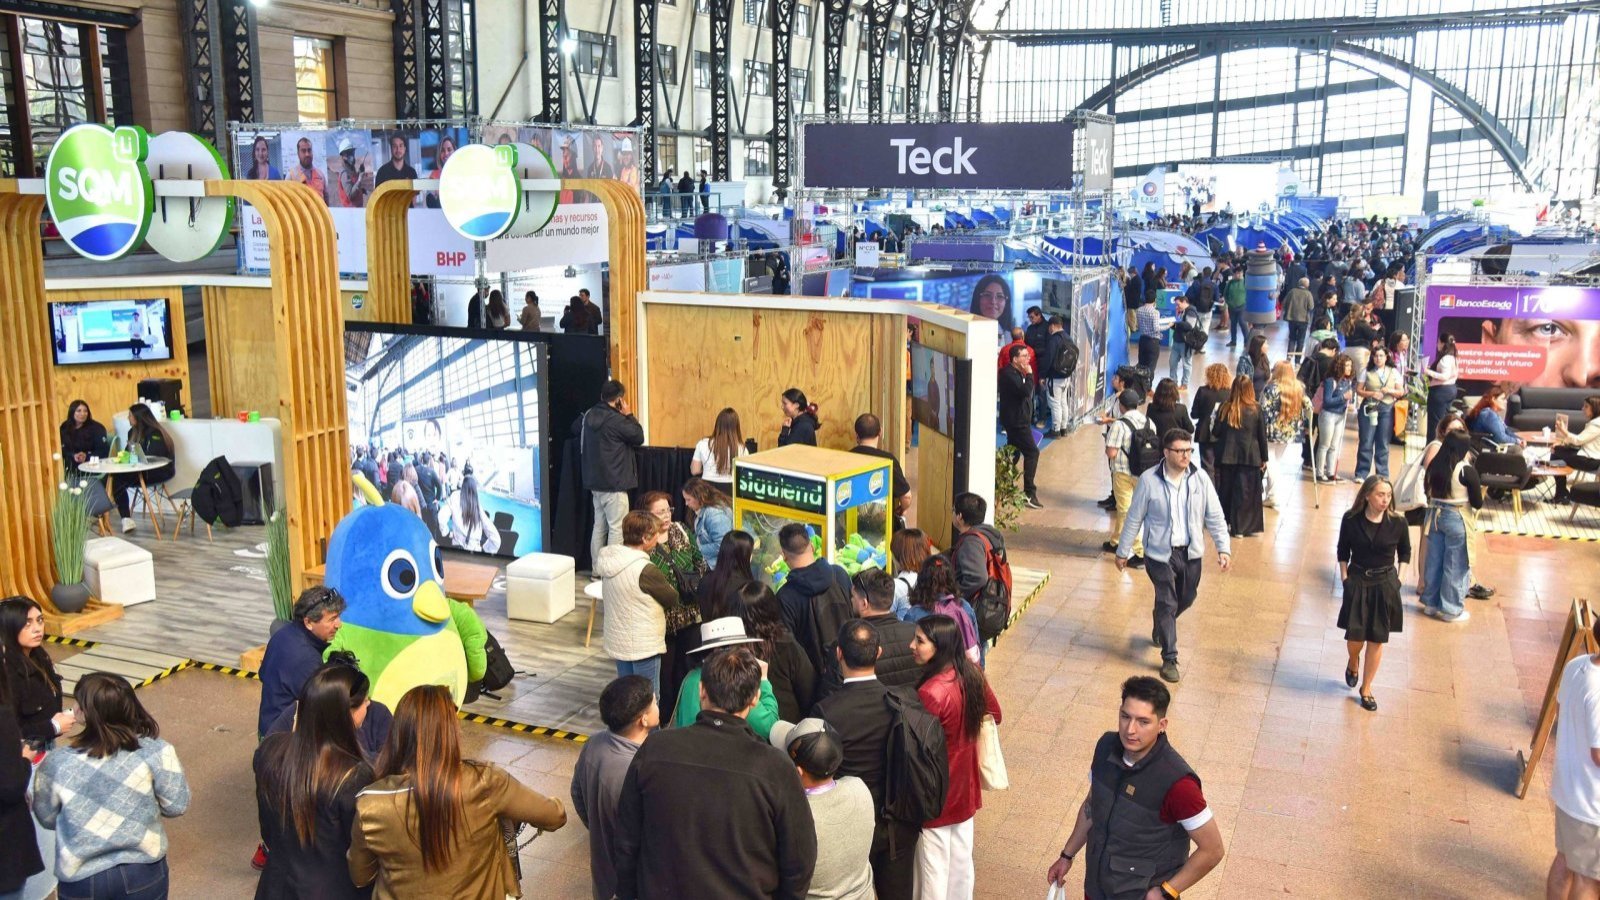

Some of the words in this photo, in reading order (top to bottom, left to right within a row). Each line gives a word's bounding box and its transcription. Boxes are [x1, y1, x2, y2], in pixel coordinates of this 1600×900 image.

[120, 136, 132, 154] Li
[889, 136, 978, 175] Teck
[1090, 138, 1108, 176] Teck
[58, 166, 133, 207] SQM
[251, 213, 262, 225] La
[565, 214, 569, 224] y
[569, 213, 598, 223] recursos
[545, 227, 555, 237] un
[556, 224, 579, 235] mundo
[580, 223, 599, 236] mejor
[436, 251, 466, 266] BHP
[1456, 299, 1512, 308] BancoEstado
